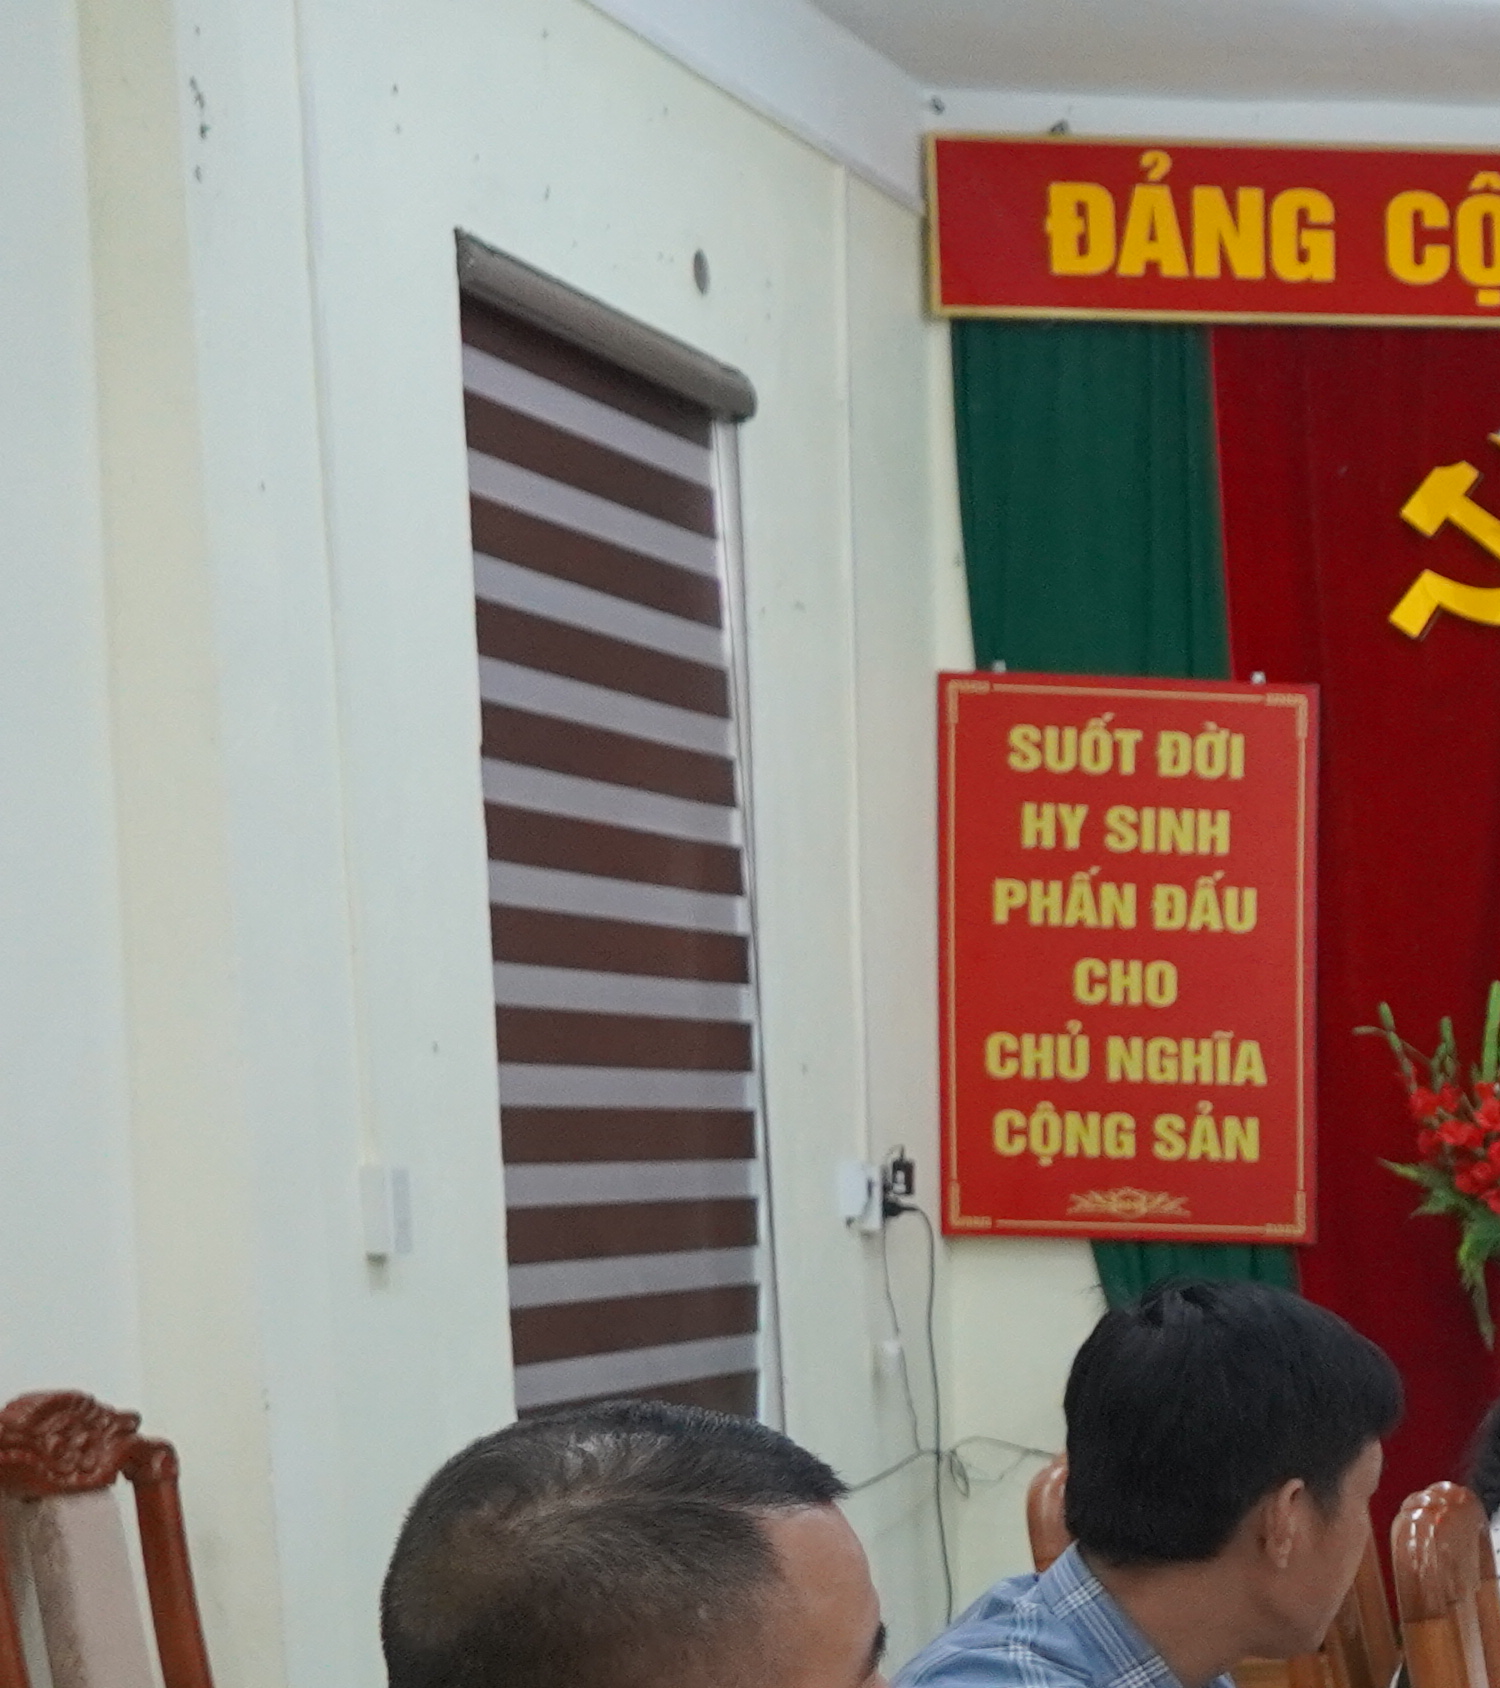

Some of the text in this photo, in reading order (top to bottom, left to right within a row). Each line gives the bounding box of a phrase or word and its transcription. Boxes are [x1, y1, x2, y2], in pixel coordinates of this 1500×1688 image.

[1046, 150, 1335, 282] ĐẢNG
[1008, 712, 1245, 779] SUỐT ĐỜI
[1022, 802, 1231, 855] HY SINH
[993, 866, 1258, 933] PHẤN ĐẤU
[1074, 958, 1178, 1008] CHO
[985, 1020, 1267, 1086] CHỦ NGHĨA
[993, 1101, 1260, 1166] CỘNG SẢN
